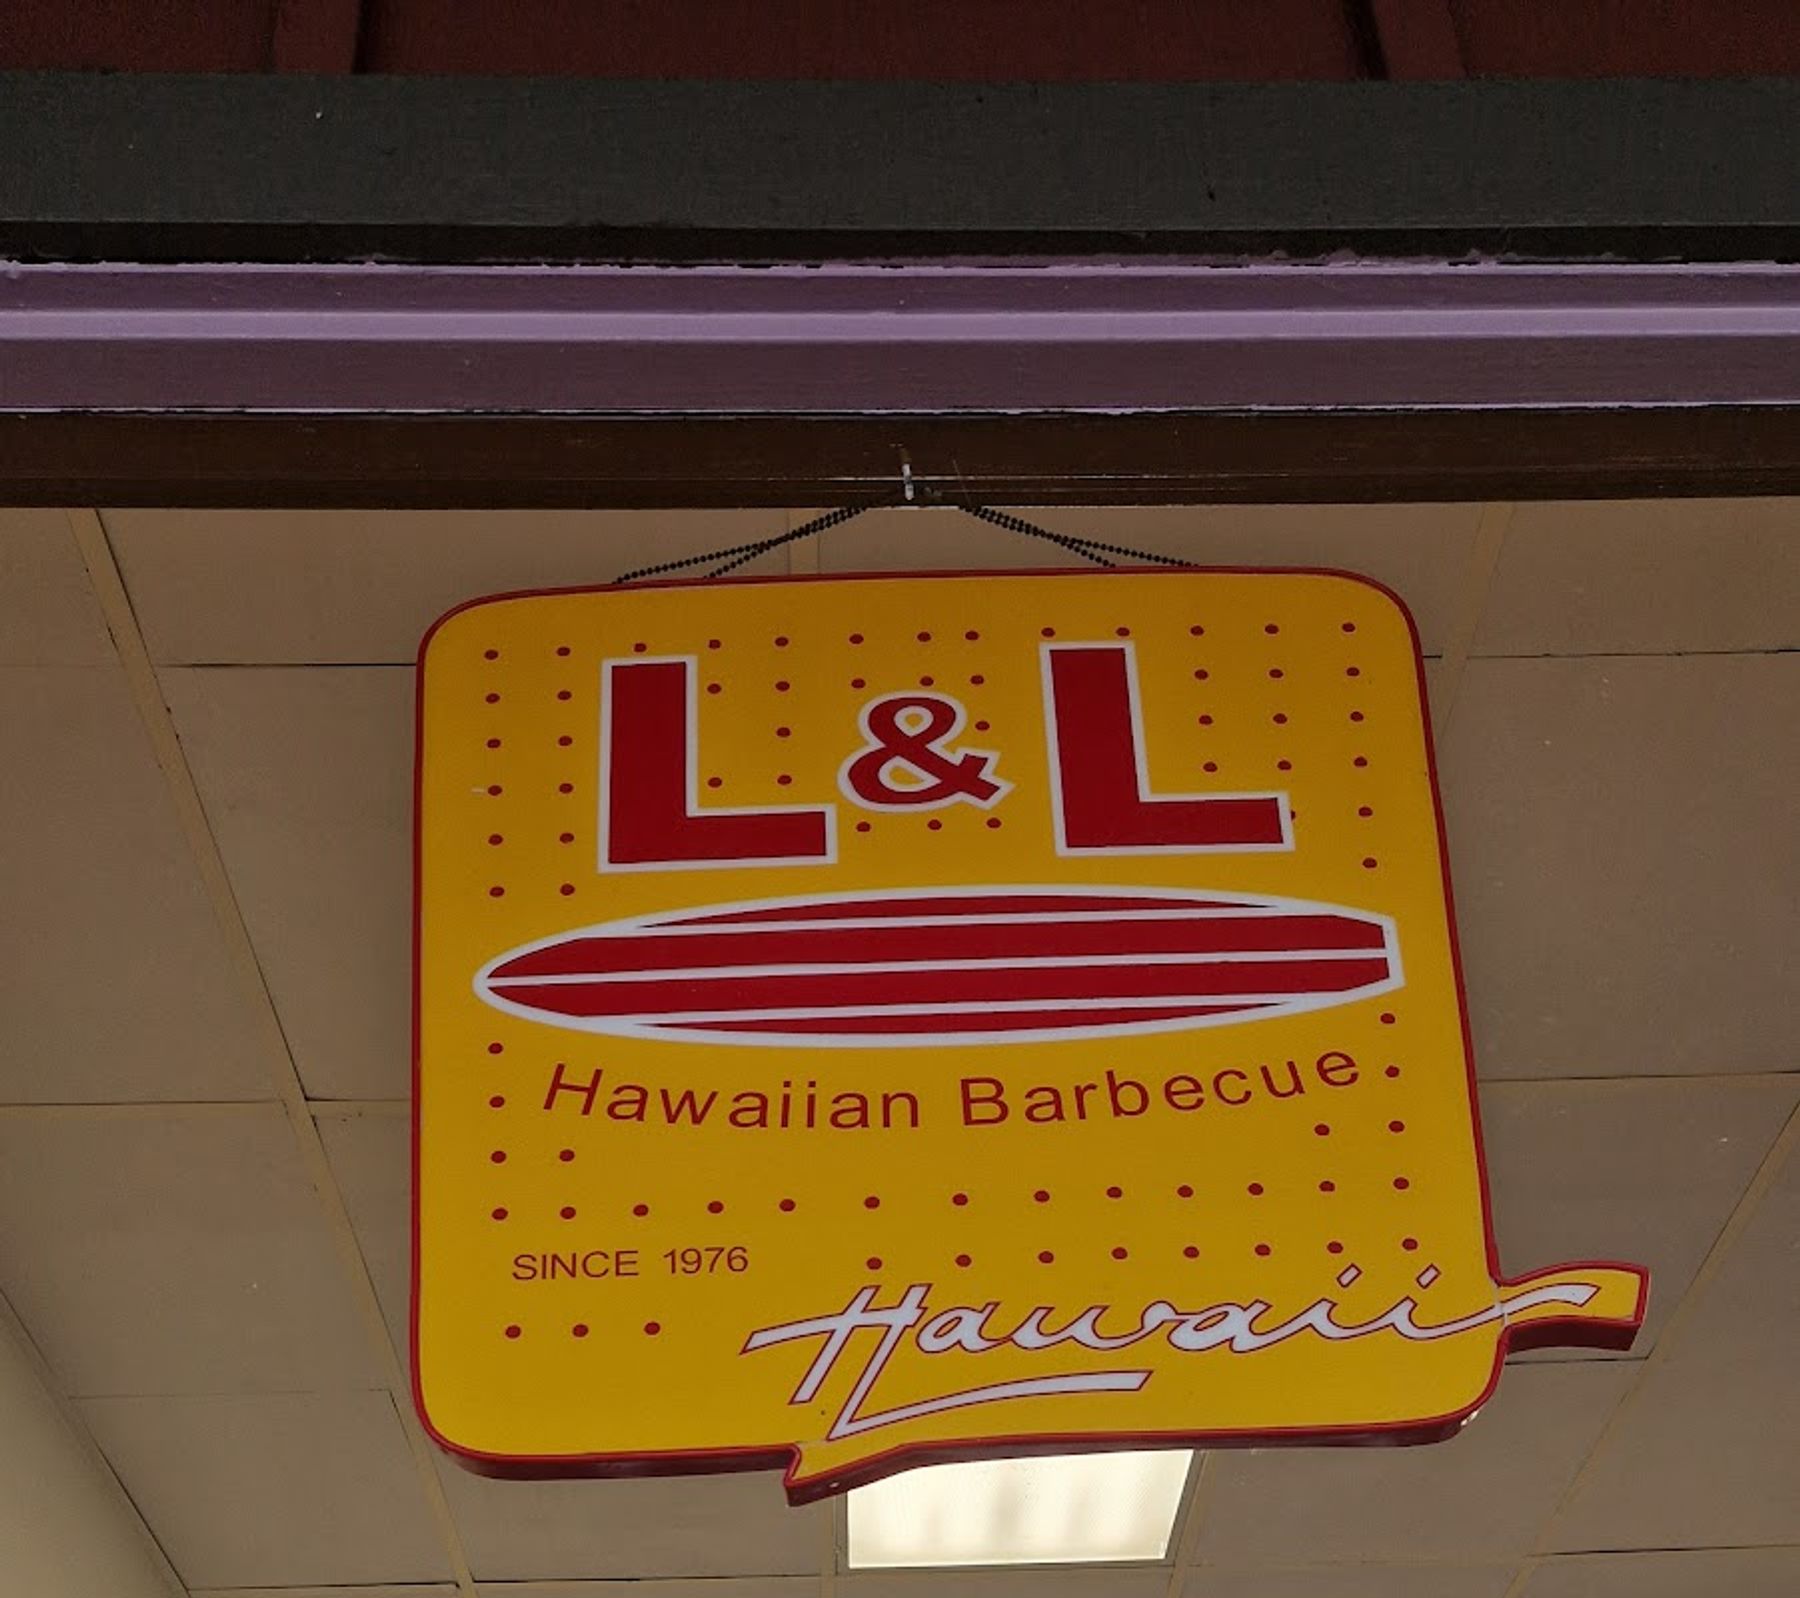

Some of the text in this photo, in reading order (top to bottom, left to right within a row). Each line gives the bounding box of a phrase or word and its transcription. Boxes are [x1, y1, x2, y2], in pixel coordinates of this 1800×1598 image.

[600, 640, 1294, 873] L&L
[542, 1046, 1362, 1129] Hawaiian Barbecue
[511, 1246, 750, 1282] SINCE 1976
[739, 1263, 1600, 1443] Hawaii
